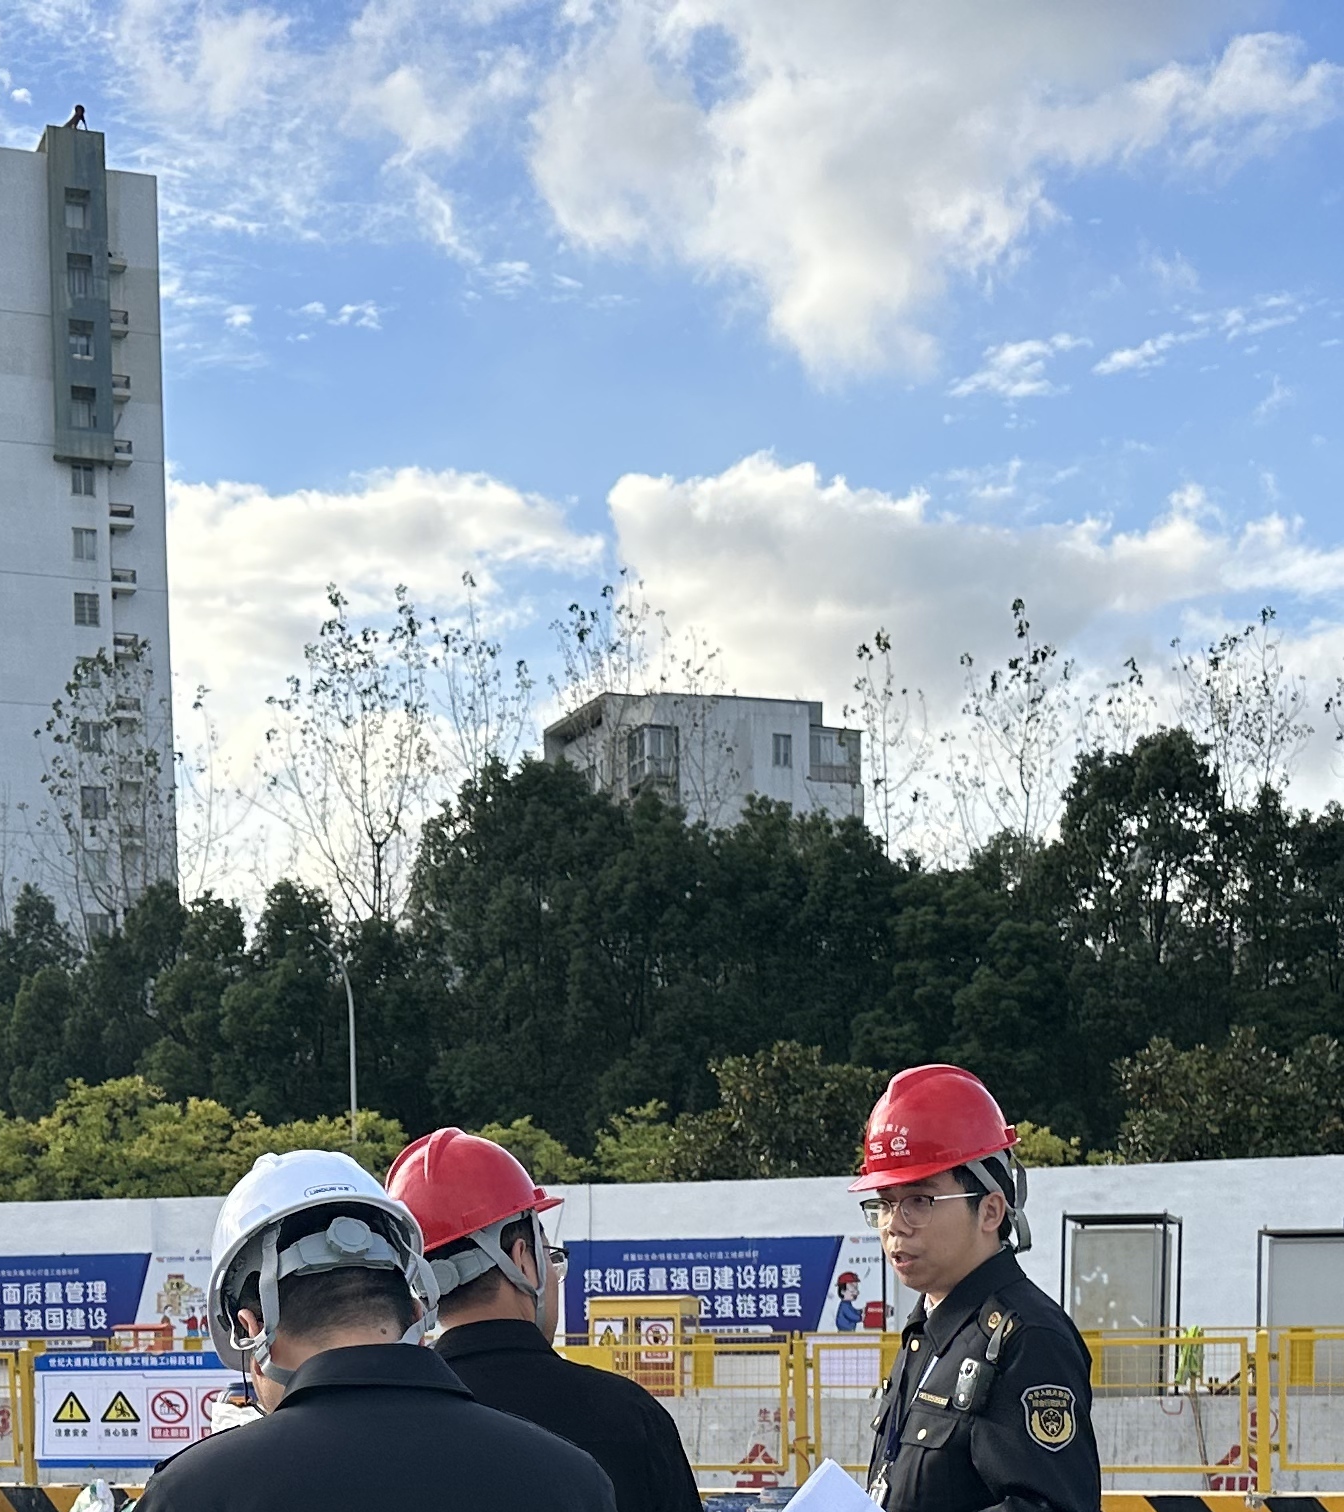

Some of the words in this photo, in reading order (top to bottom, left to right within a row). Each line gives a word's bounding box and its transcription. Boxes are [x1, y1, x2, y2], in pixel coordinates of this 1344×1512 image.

[583, 1264, 802, 1293] 贯彻质量强国建设纲要
[55, 1428, 88, 1437] 注意安全
[104, 1428, 138, 1437] 当心坠落
